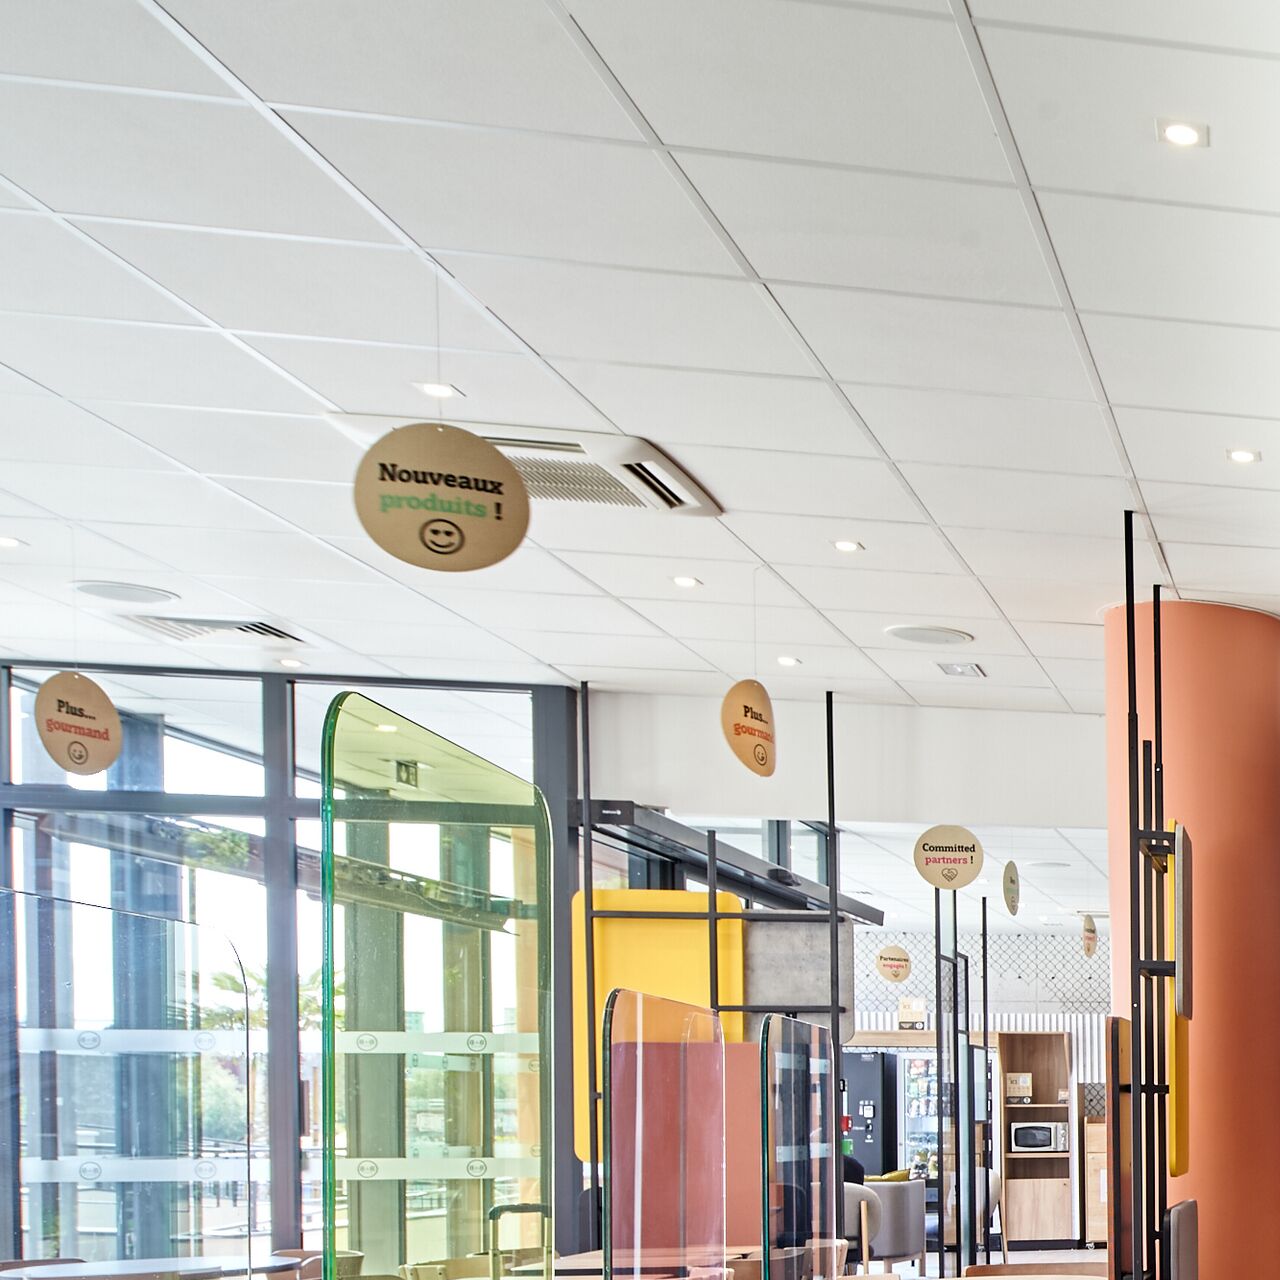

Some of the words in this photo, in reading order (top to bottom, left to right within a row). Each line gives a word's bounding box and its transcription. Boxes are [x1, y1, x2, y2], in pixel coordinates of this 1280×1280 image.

[378, 463, 504, 495] Nouveaux
[379, 493, 488, 518] produits
[494, 502, 503, 520] !
[46, 718, 110, 741] gourmand
[922, 843, 976, 853] Committed
[925, 856, 968, 866] partners
